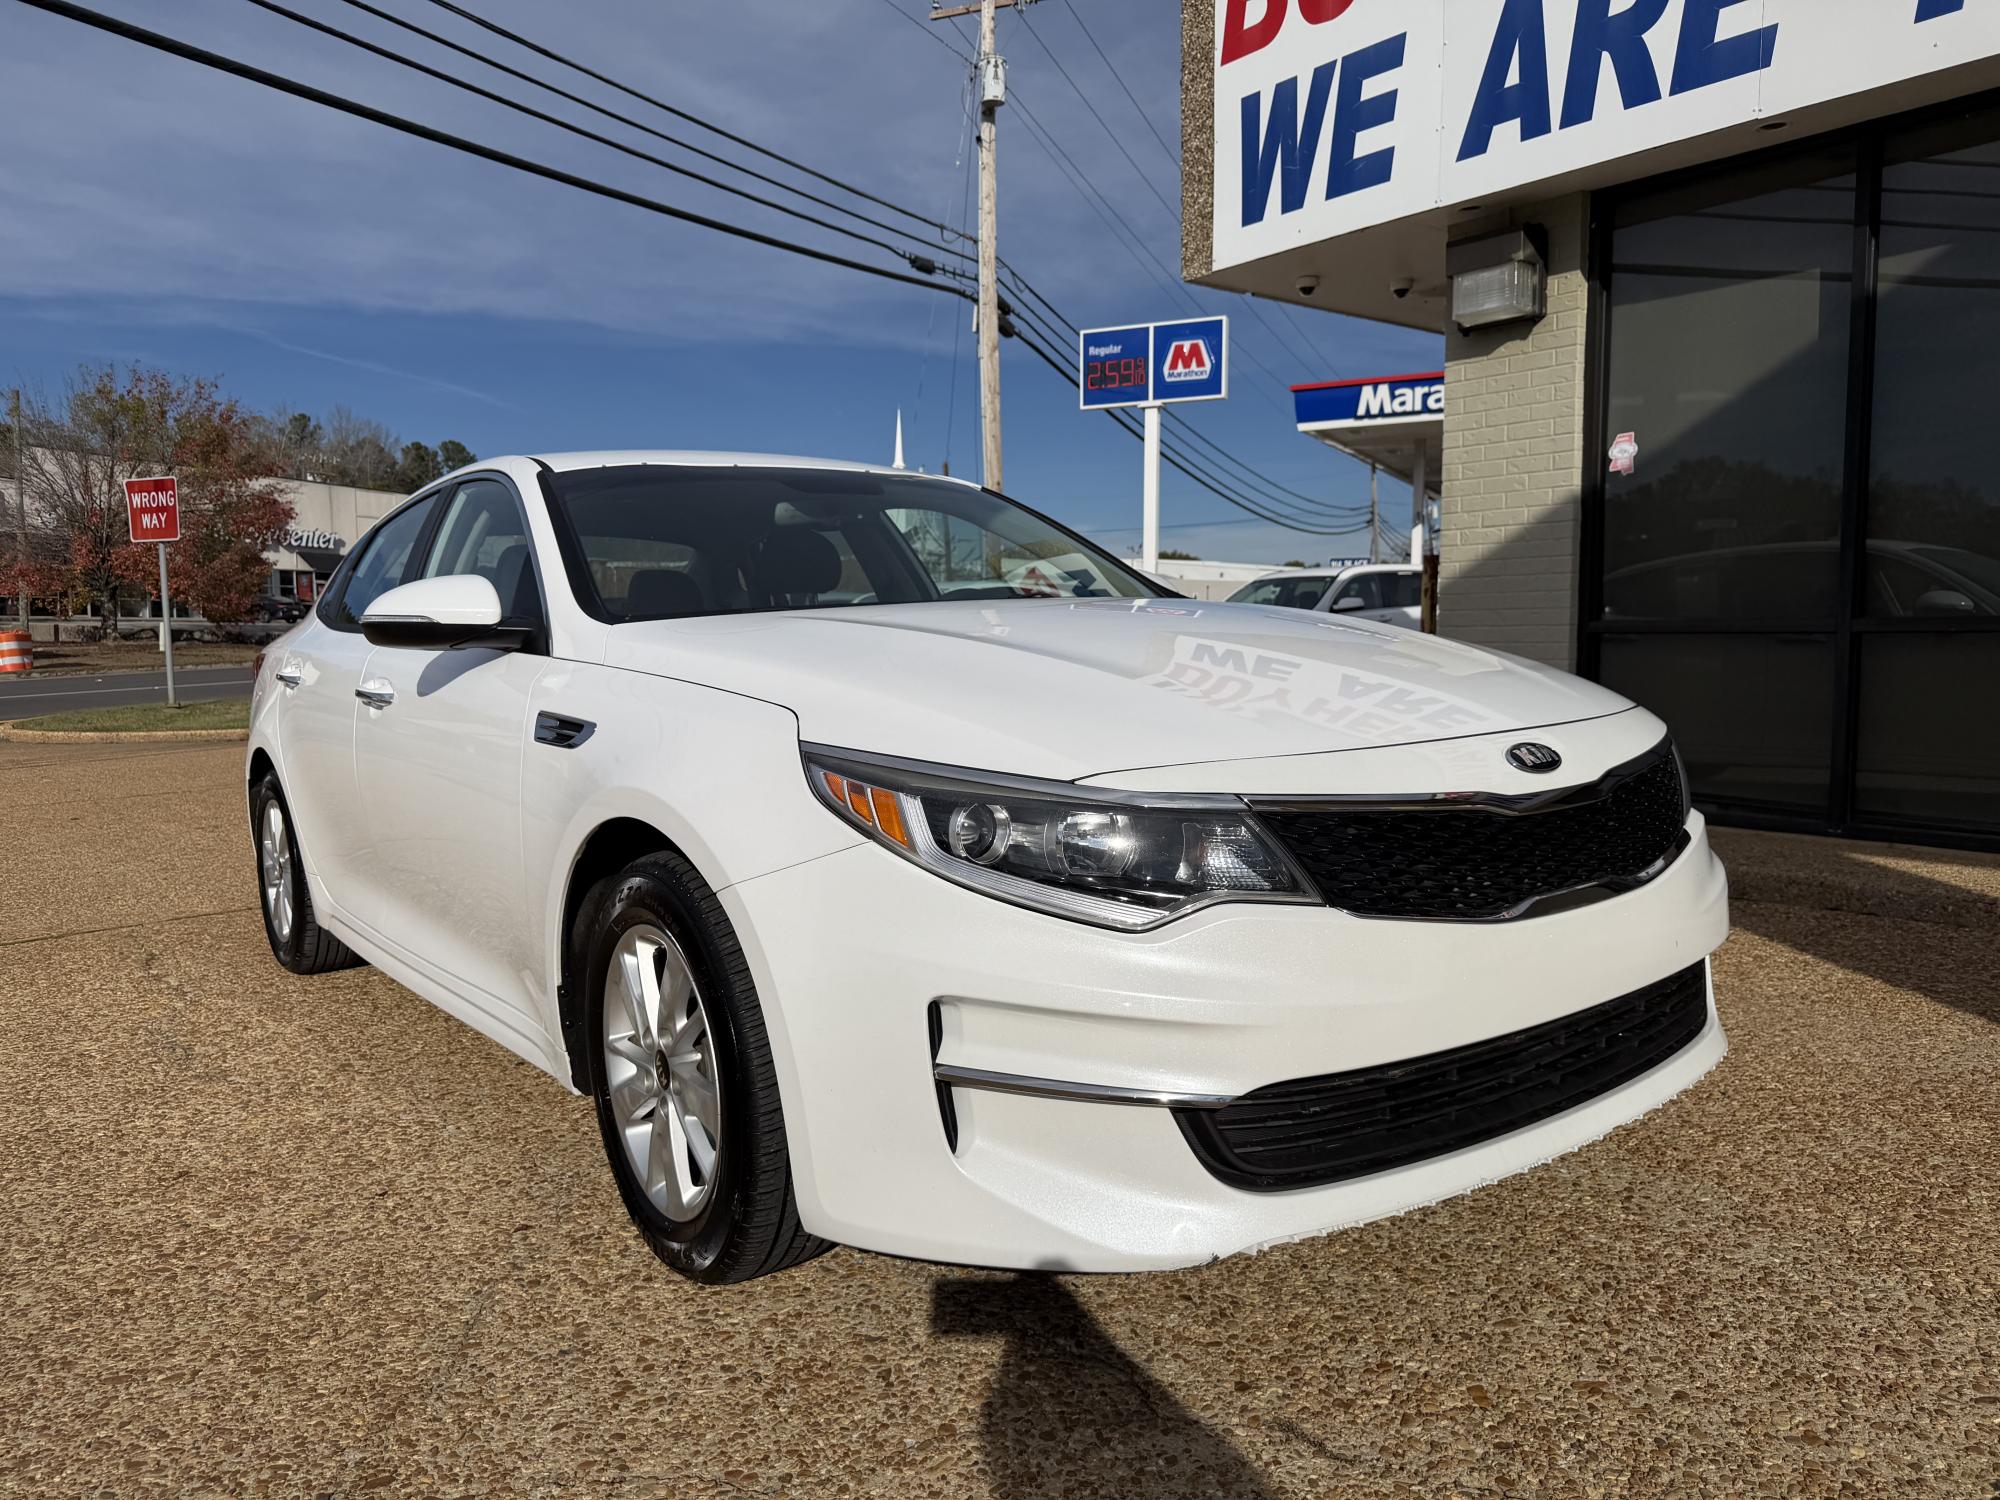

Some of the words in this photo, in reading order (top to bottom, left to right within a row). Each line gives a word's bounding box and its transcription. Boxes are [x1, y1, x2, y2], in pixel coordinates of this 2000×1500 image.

[1241, 32, 1407, 227] WE
[1456, 0, 1779, 162] ARE
[1088, 344, 1122, 357] Regular
[1167, 369, 1208, 379] Marathon
[131, 490, 175, 508] WRONG
[141, 512, 167, 529] WAY
